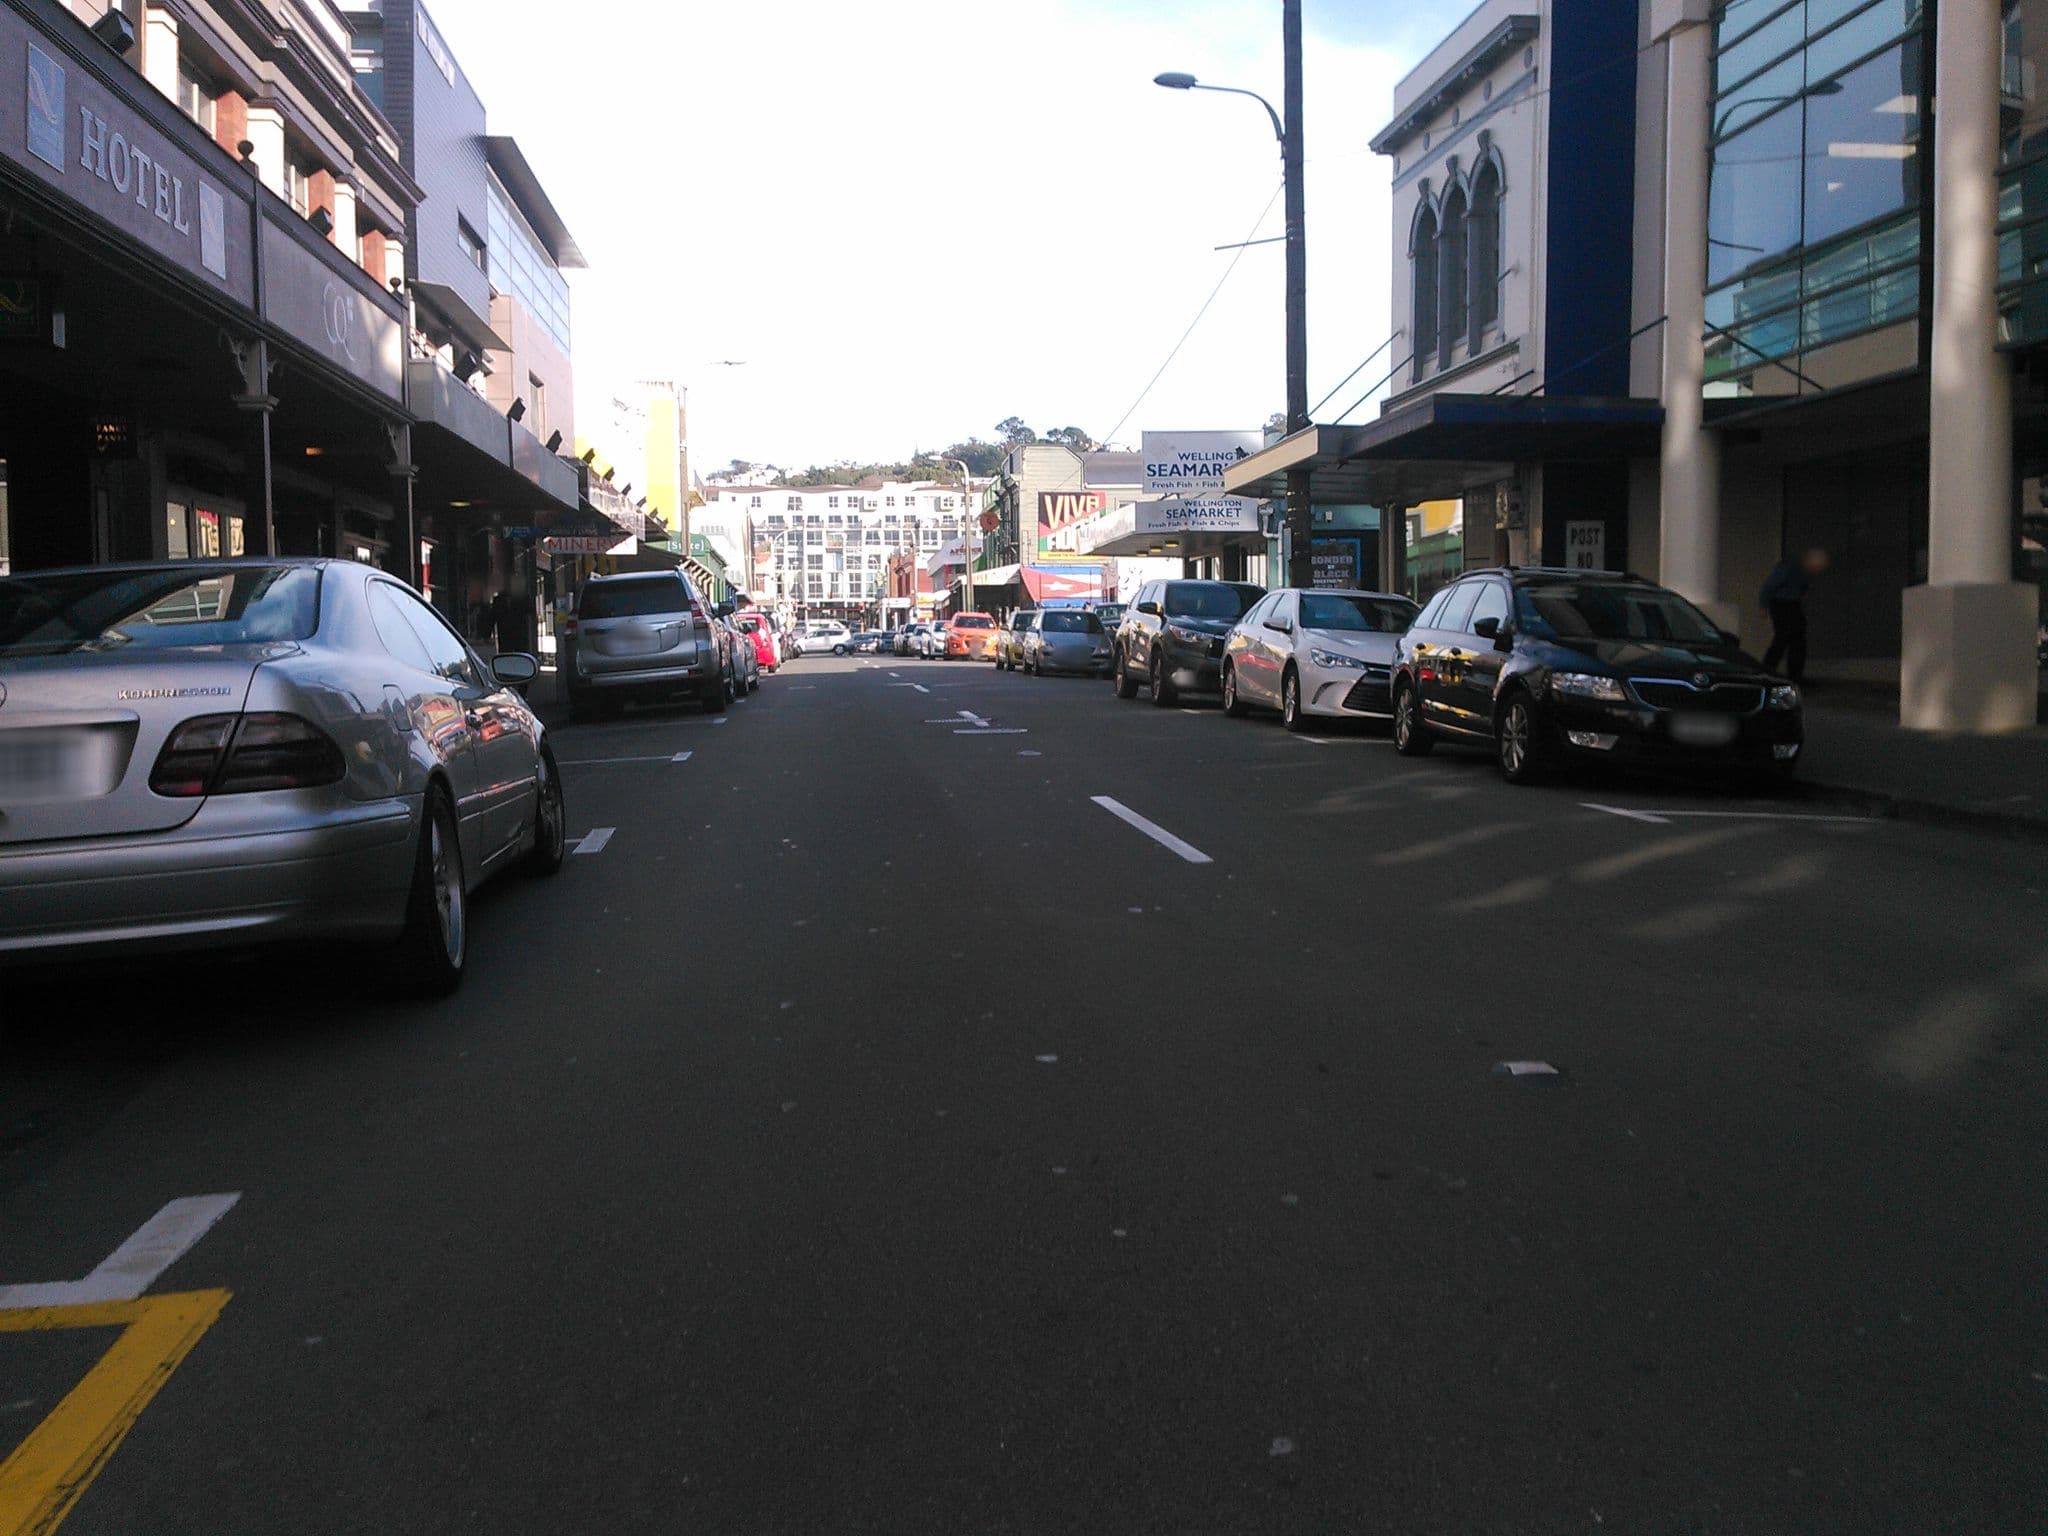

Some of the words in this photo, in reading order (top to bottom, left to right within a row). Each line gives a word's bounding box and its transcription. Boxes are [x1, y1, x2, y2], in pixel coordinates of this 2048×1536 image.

[80, 106, 189, 236] HOTEL
[1178, 452, 1246, 461] WELLING
[1147, 463, 1227, 477] SEAMAR
[1044, 494, 1099, 530] VIVA
[1166, 507, 1242, 519] SEAMARKET
[1571, 527, 1600, 545] POST
